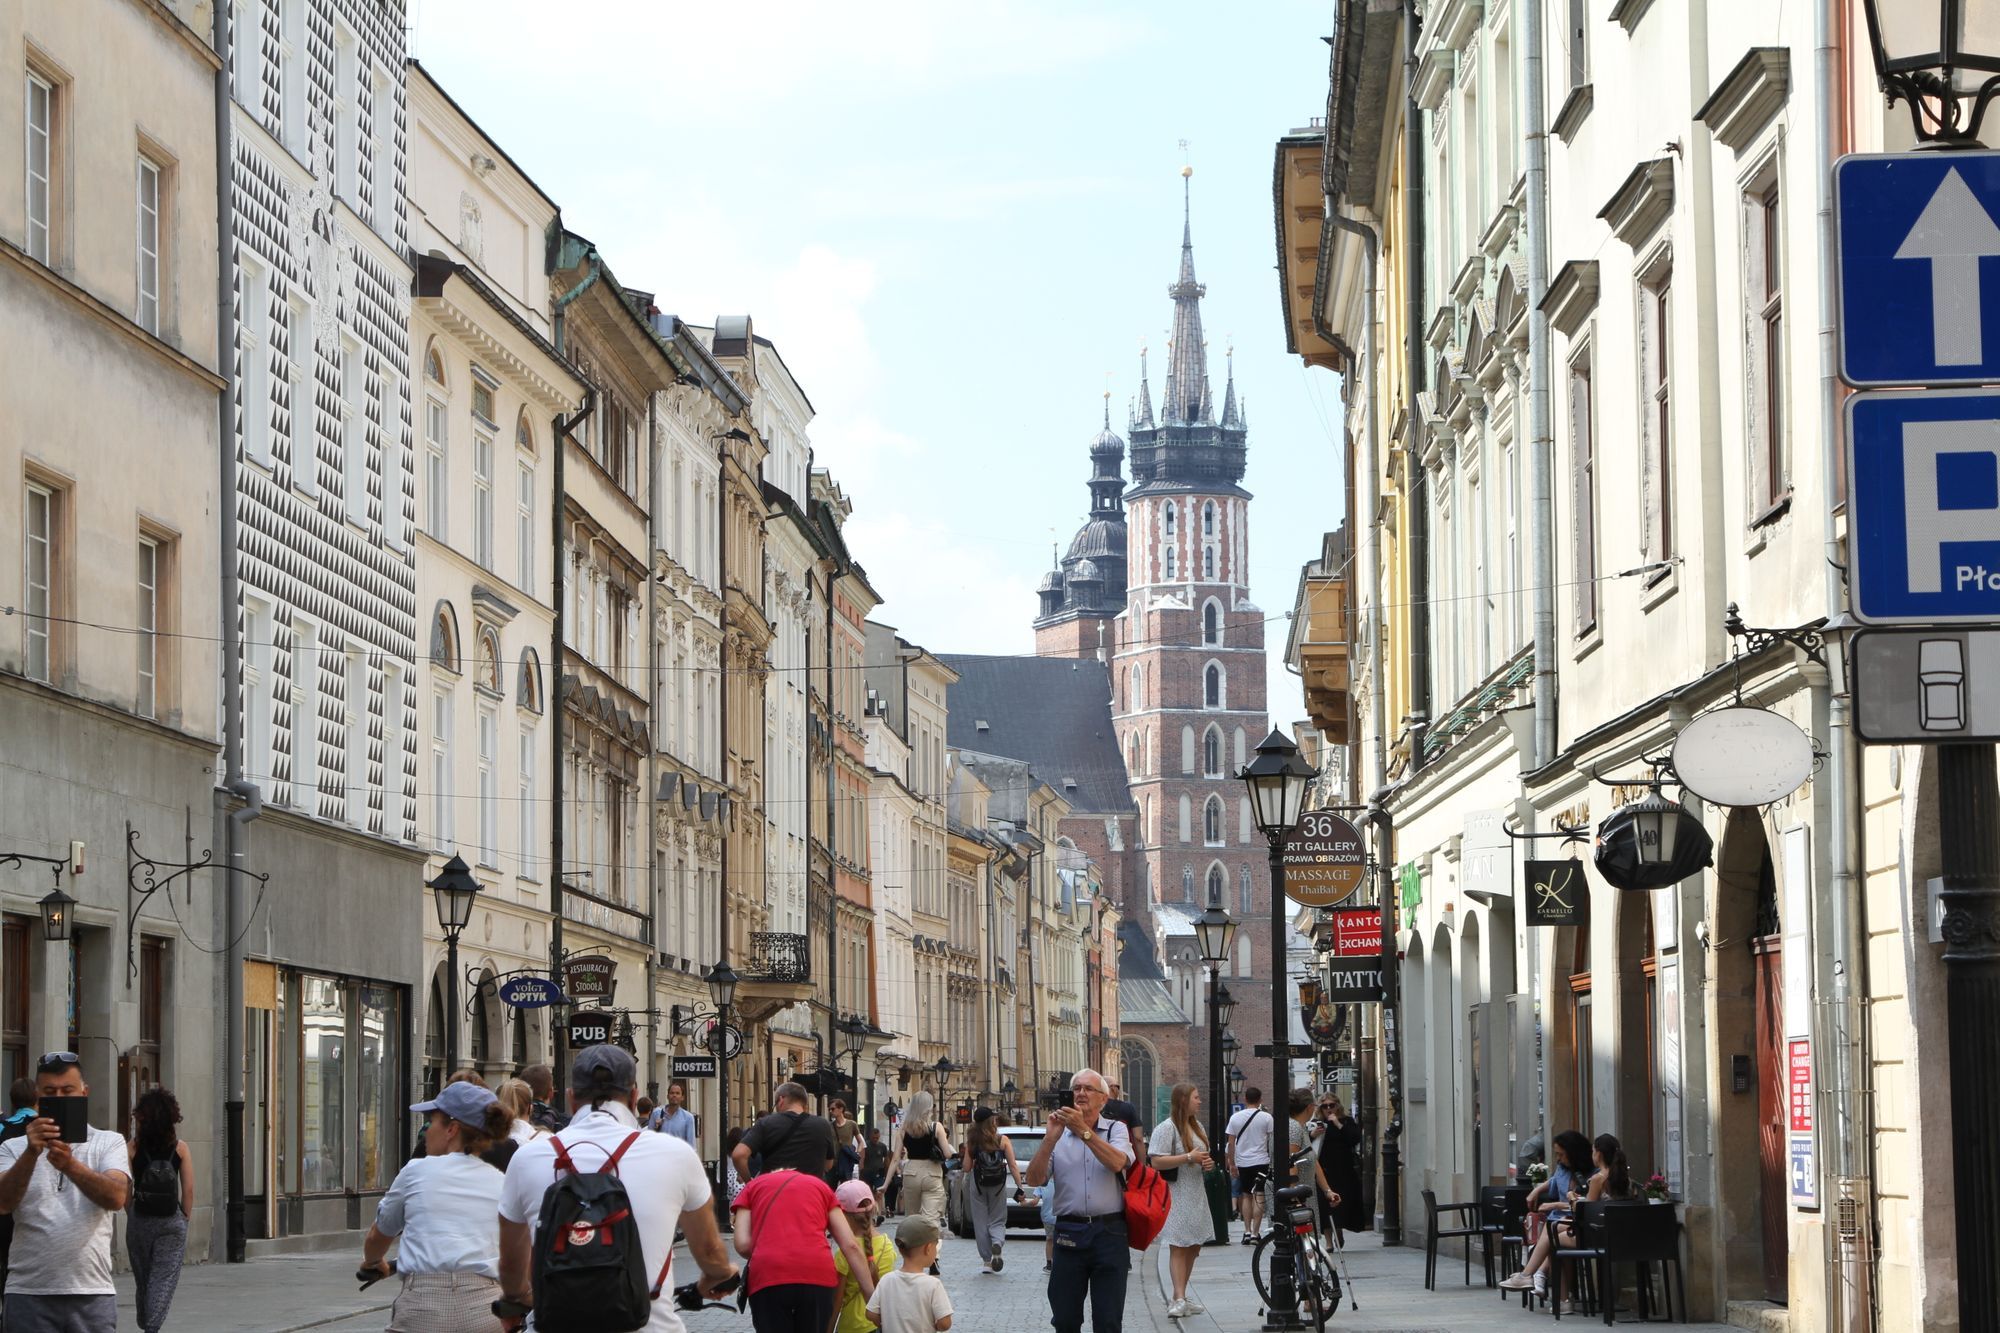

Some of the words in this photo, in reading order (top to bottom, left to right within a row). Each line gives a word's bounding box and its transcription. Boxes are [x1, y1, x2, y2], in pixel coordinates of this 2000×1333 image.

[1303, 816, 1332, 837] 36
[1643, 830, 1657, 846] 40
[1285, 842, 1302, 851] RT
[1305, 842, 1357, 851] GALLERY
[1283, 855, 1314, 863] PRAWA
[1315, 854, 1360, 863] OBRAZÓW
[1285, 869, 1351, 881] MASSAGE
[1300, 885, 1337, 895] ThaiBali
[1337, 916, 1382, 928] KANTO
[1340, 938, 1382, 949] EXCHAN
[570, 963, 609, 975] RESTAURACJA
[1332, 970, 1383, 988] TATT
[510, 992, 547, 1002] OPTYK
[572, 1027, 606, 1041] PUB
[674, 1062, 714, 1072] HOSTEL
